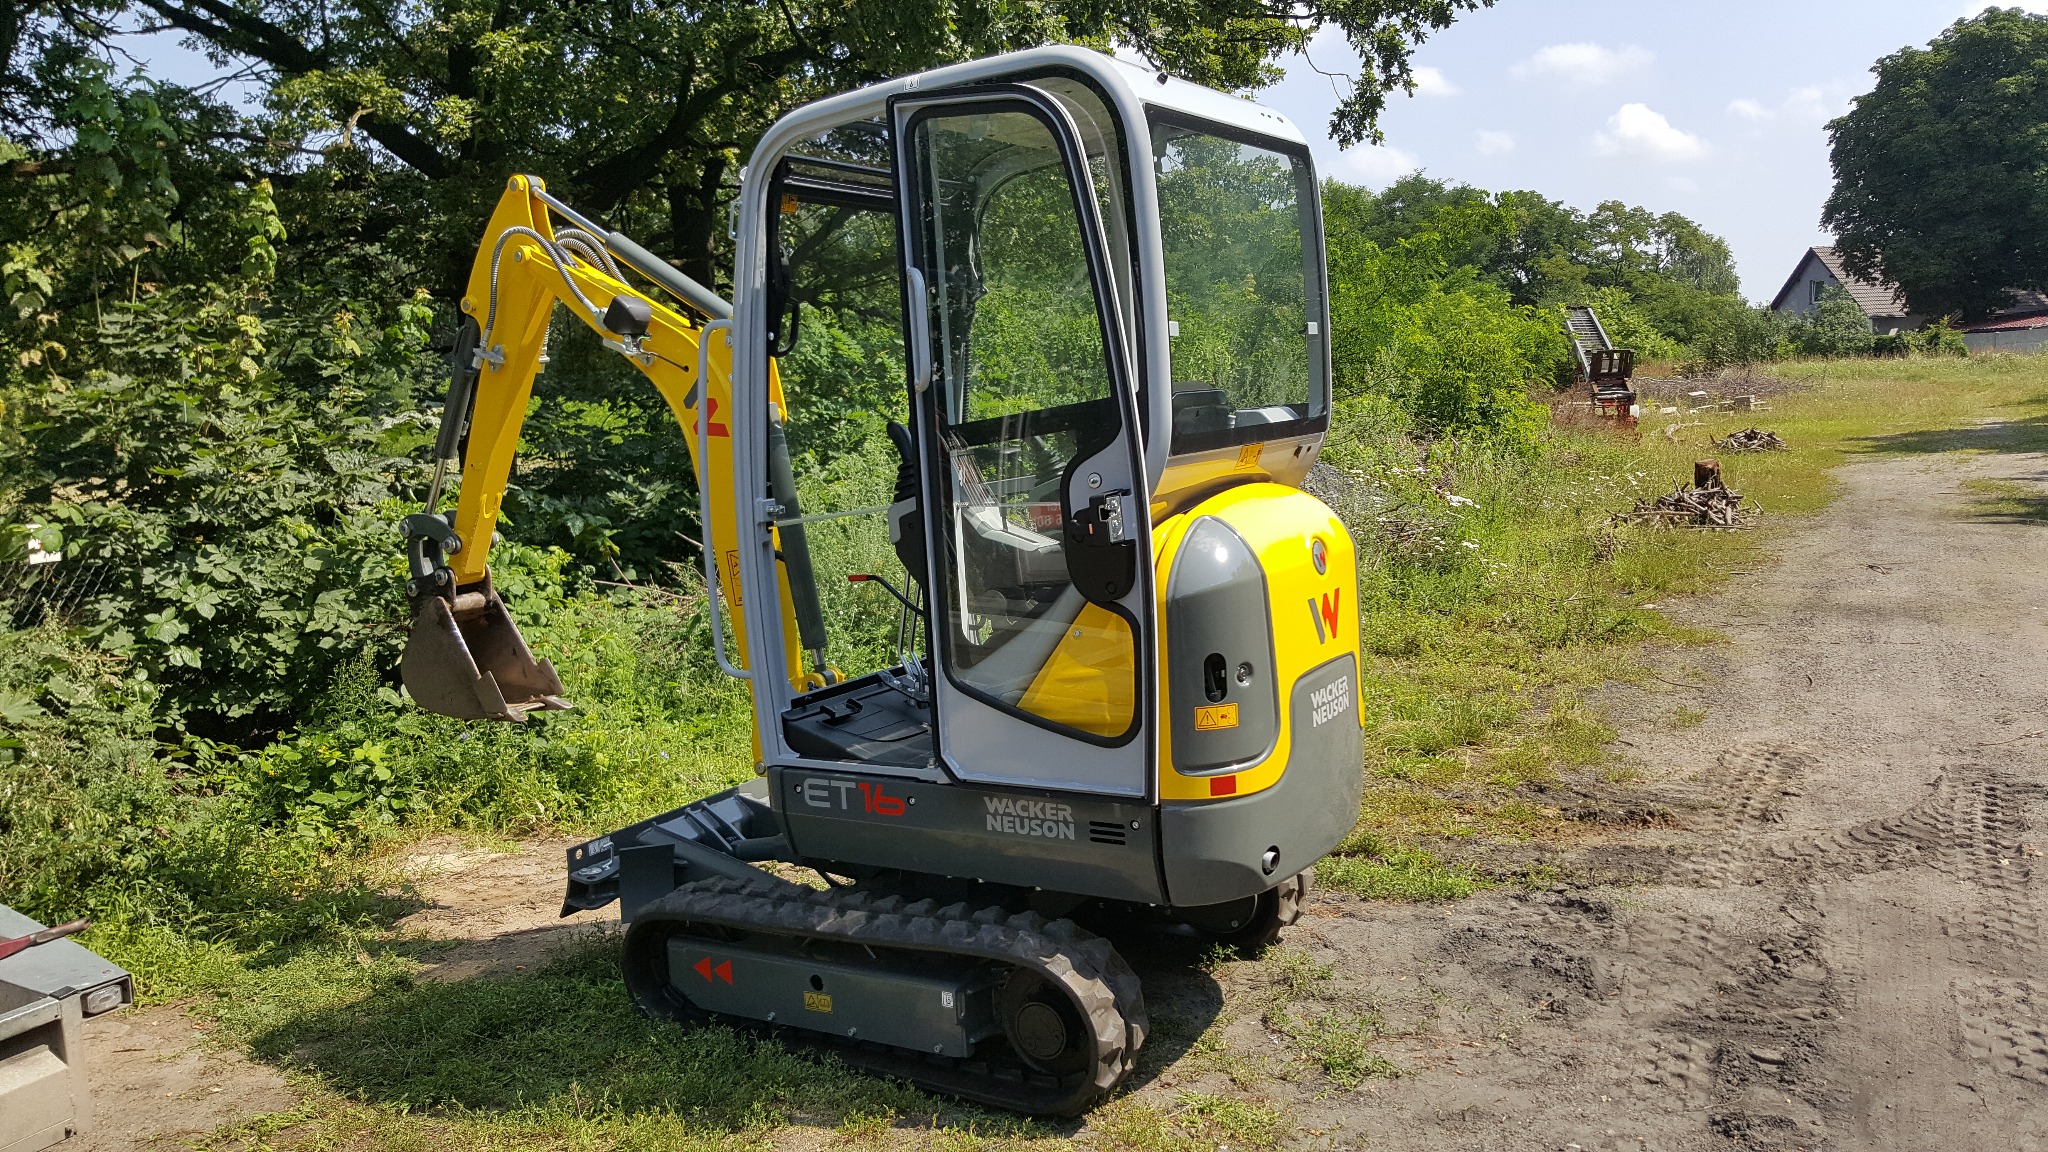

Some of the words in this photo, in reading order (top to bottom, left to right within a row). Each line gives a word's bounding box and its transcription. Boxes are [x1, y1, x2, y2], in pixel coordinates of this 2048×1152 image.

[1307, 587, 1340, 645] W
[1310, 675, 1349, 709] WACKER
[1312, 691, 1350, 728] NEUSON
[803, 778, 906, 816] ET16
[983, 796, 1074, 822] WACKER
[986, 814, 1076, 840] NEUSON
